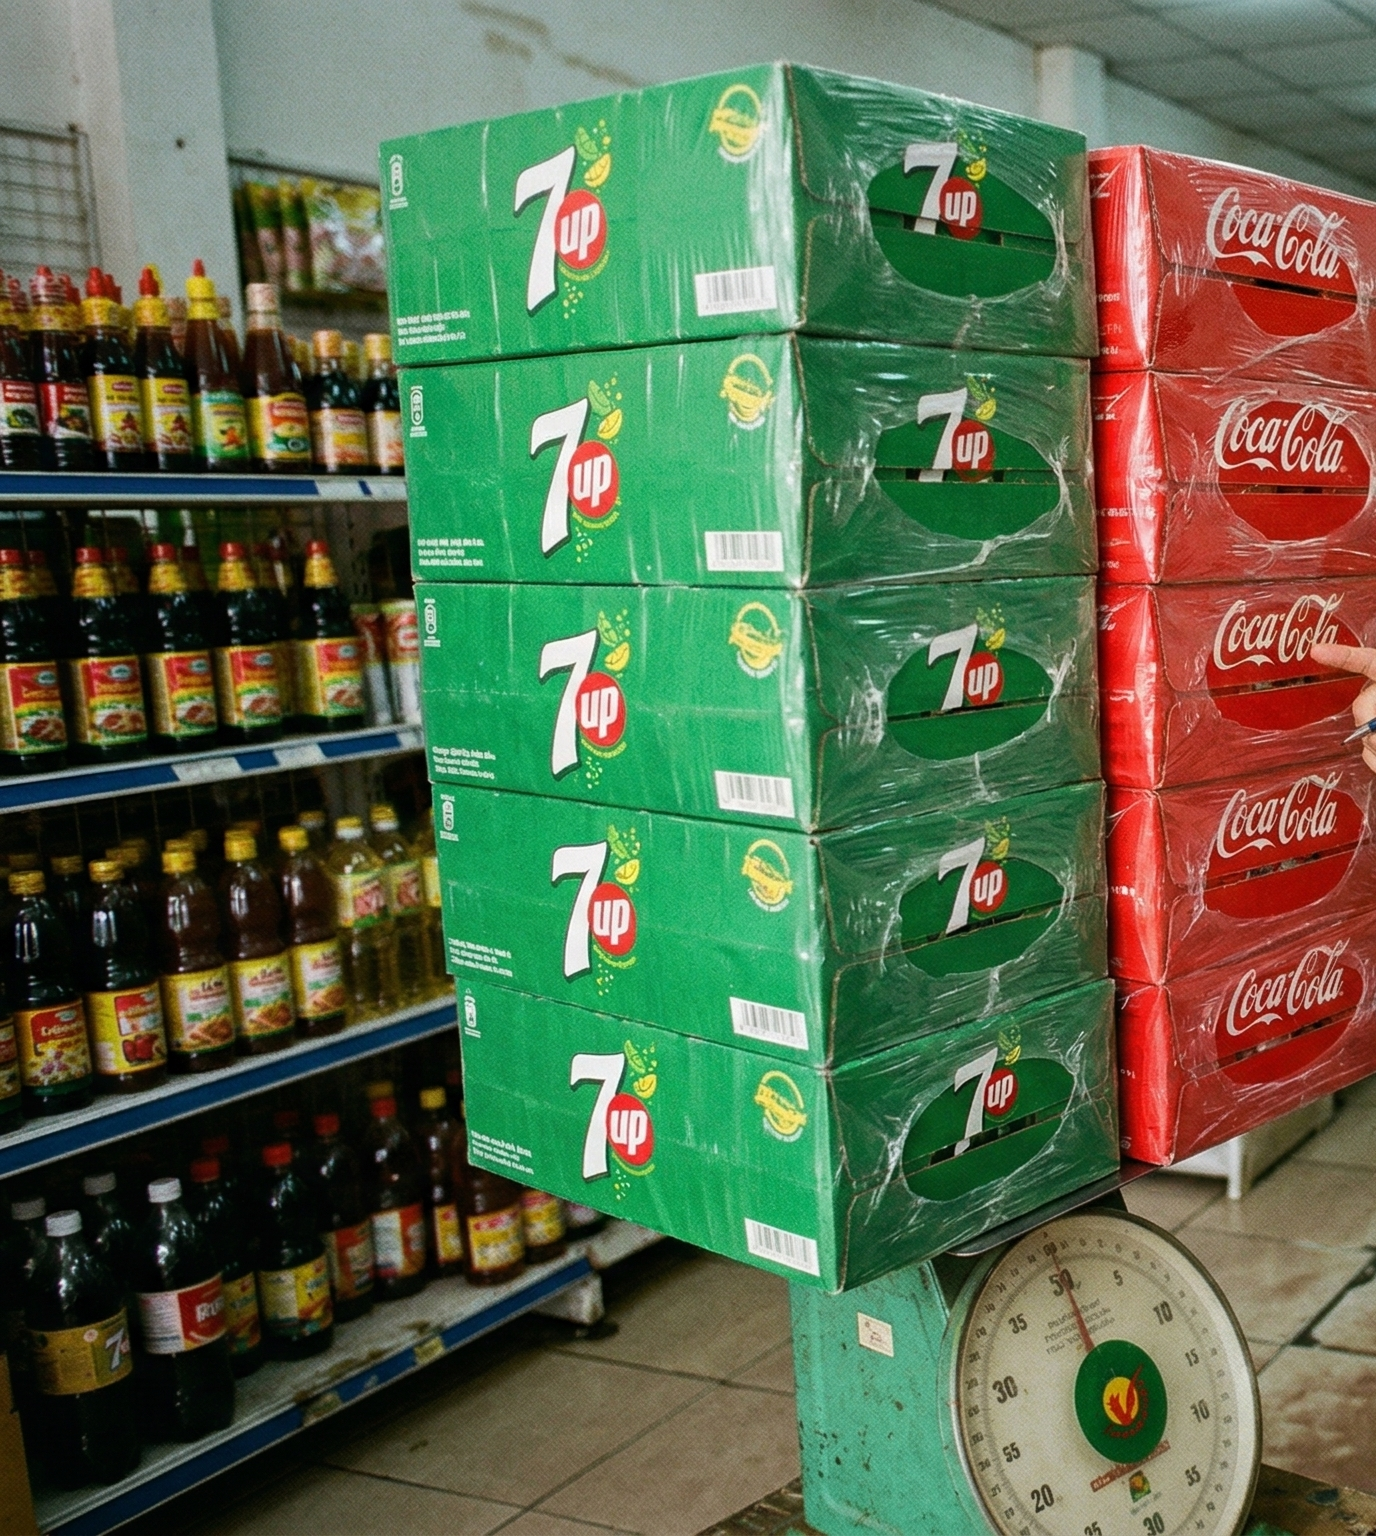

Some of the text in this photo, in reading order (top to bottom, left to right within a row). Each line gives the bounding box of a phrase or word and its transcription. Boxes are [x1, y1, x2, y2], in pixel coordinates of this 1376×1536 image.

[1206, 187, 1348, 279] Coca-Cola
[1214, 400, 1356, 474] Coca-Cola
[1216, 771, 1343, 858] Coca-Cola
[1226, 938, 1350, 1036] Coca-Cola
[1113, 1270, 1124, 1287] 5
[1008, 1313, 1028, 1334] 35
[1153, 1301, 1174, 1326] 10
[1185, 1348, 1200, 1367] 15
[992, 1375, 1019, 1404] 30
[1002, 1442, 1021, 1463] 55
[1031, 1484, 1055, 1514] 20
[1143, 1511, 1165, 1536] 30
